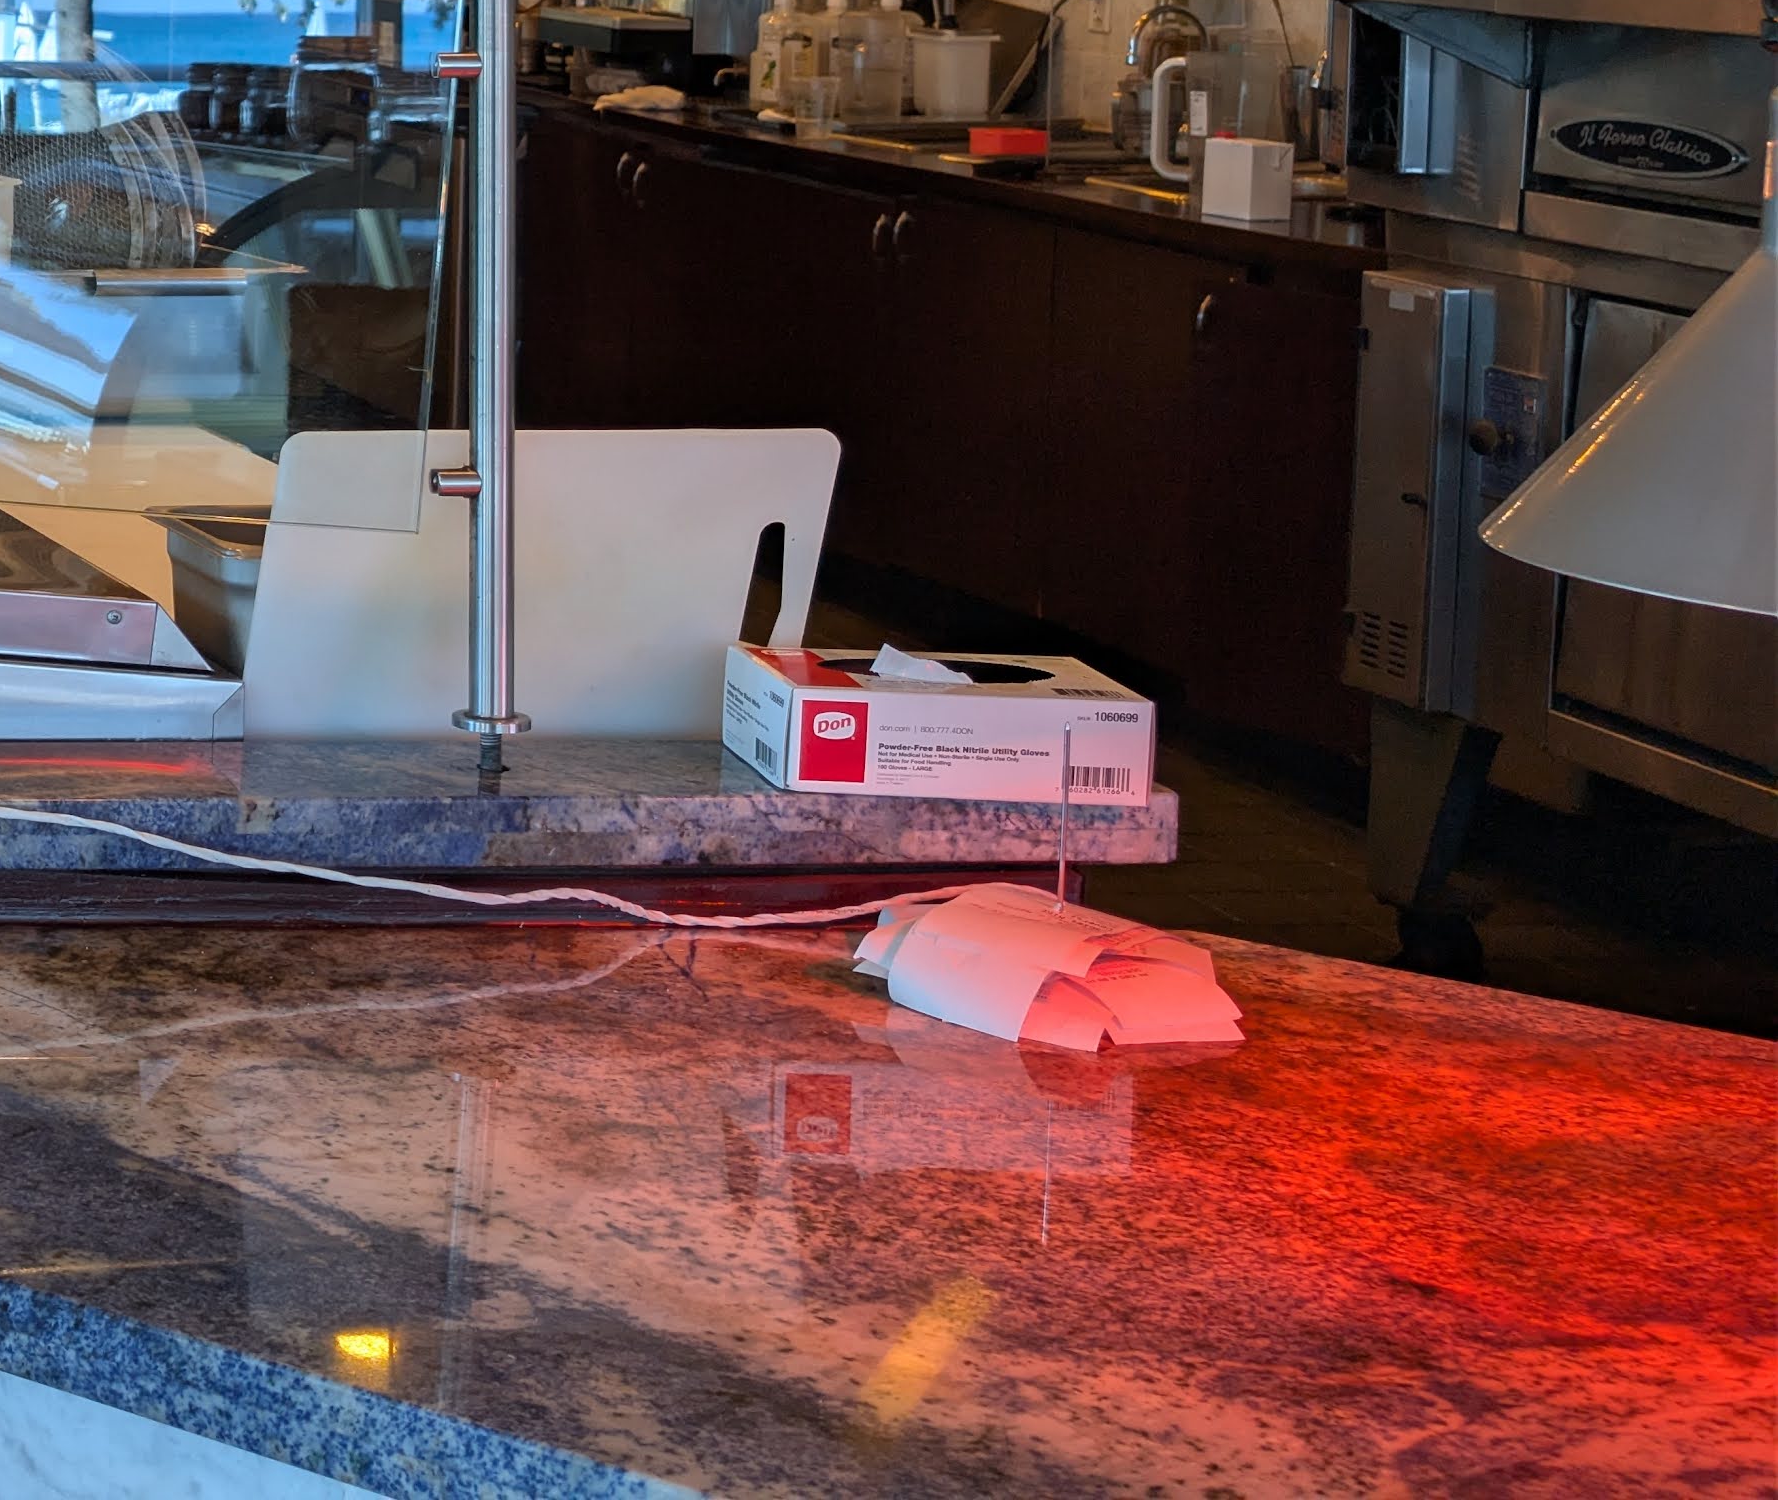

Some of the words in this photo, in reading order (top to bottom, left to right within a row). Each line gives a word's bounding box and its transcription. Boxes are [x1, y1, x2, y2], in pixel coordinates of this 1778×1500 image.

[1095, 712, 1139, 723] 1060699
[817, 717, 852, 734] Don
[879, 724, 911, 732] don.com
[878, 743, 933, 752] Powder-Free
[936, 745, 960, 754] Black
[963, 746, 990, 755] Nitrile
[992, 747, 1018, 757] Utility
[1020, 749, 1050, 757] Gloves
[1069, 786, 1093, 794] 60282
